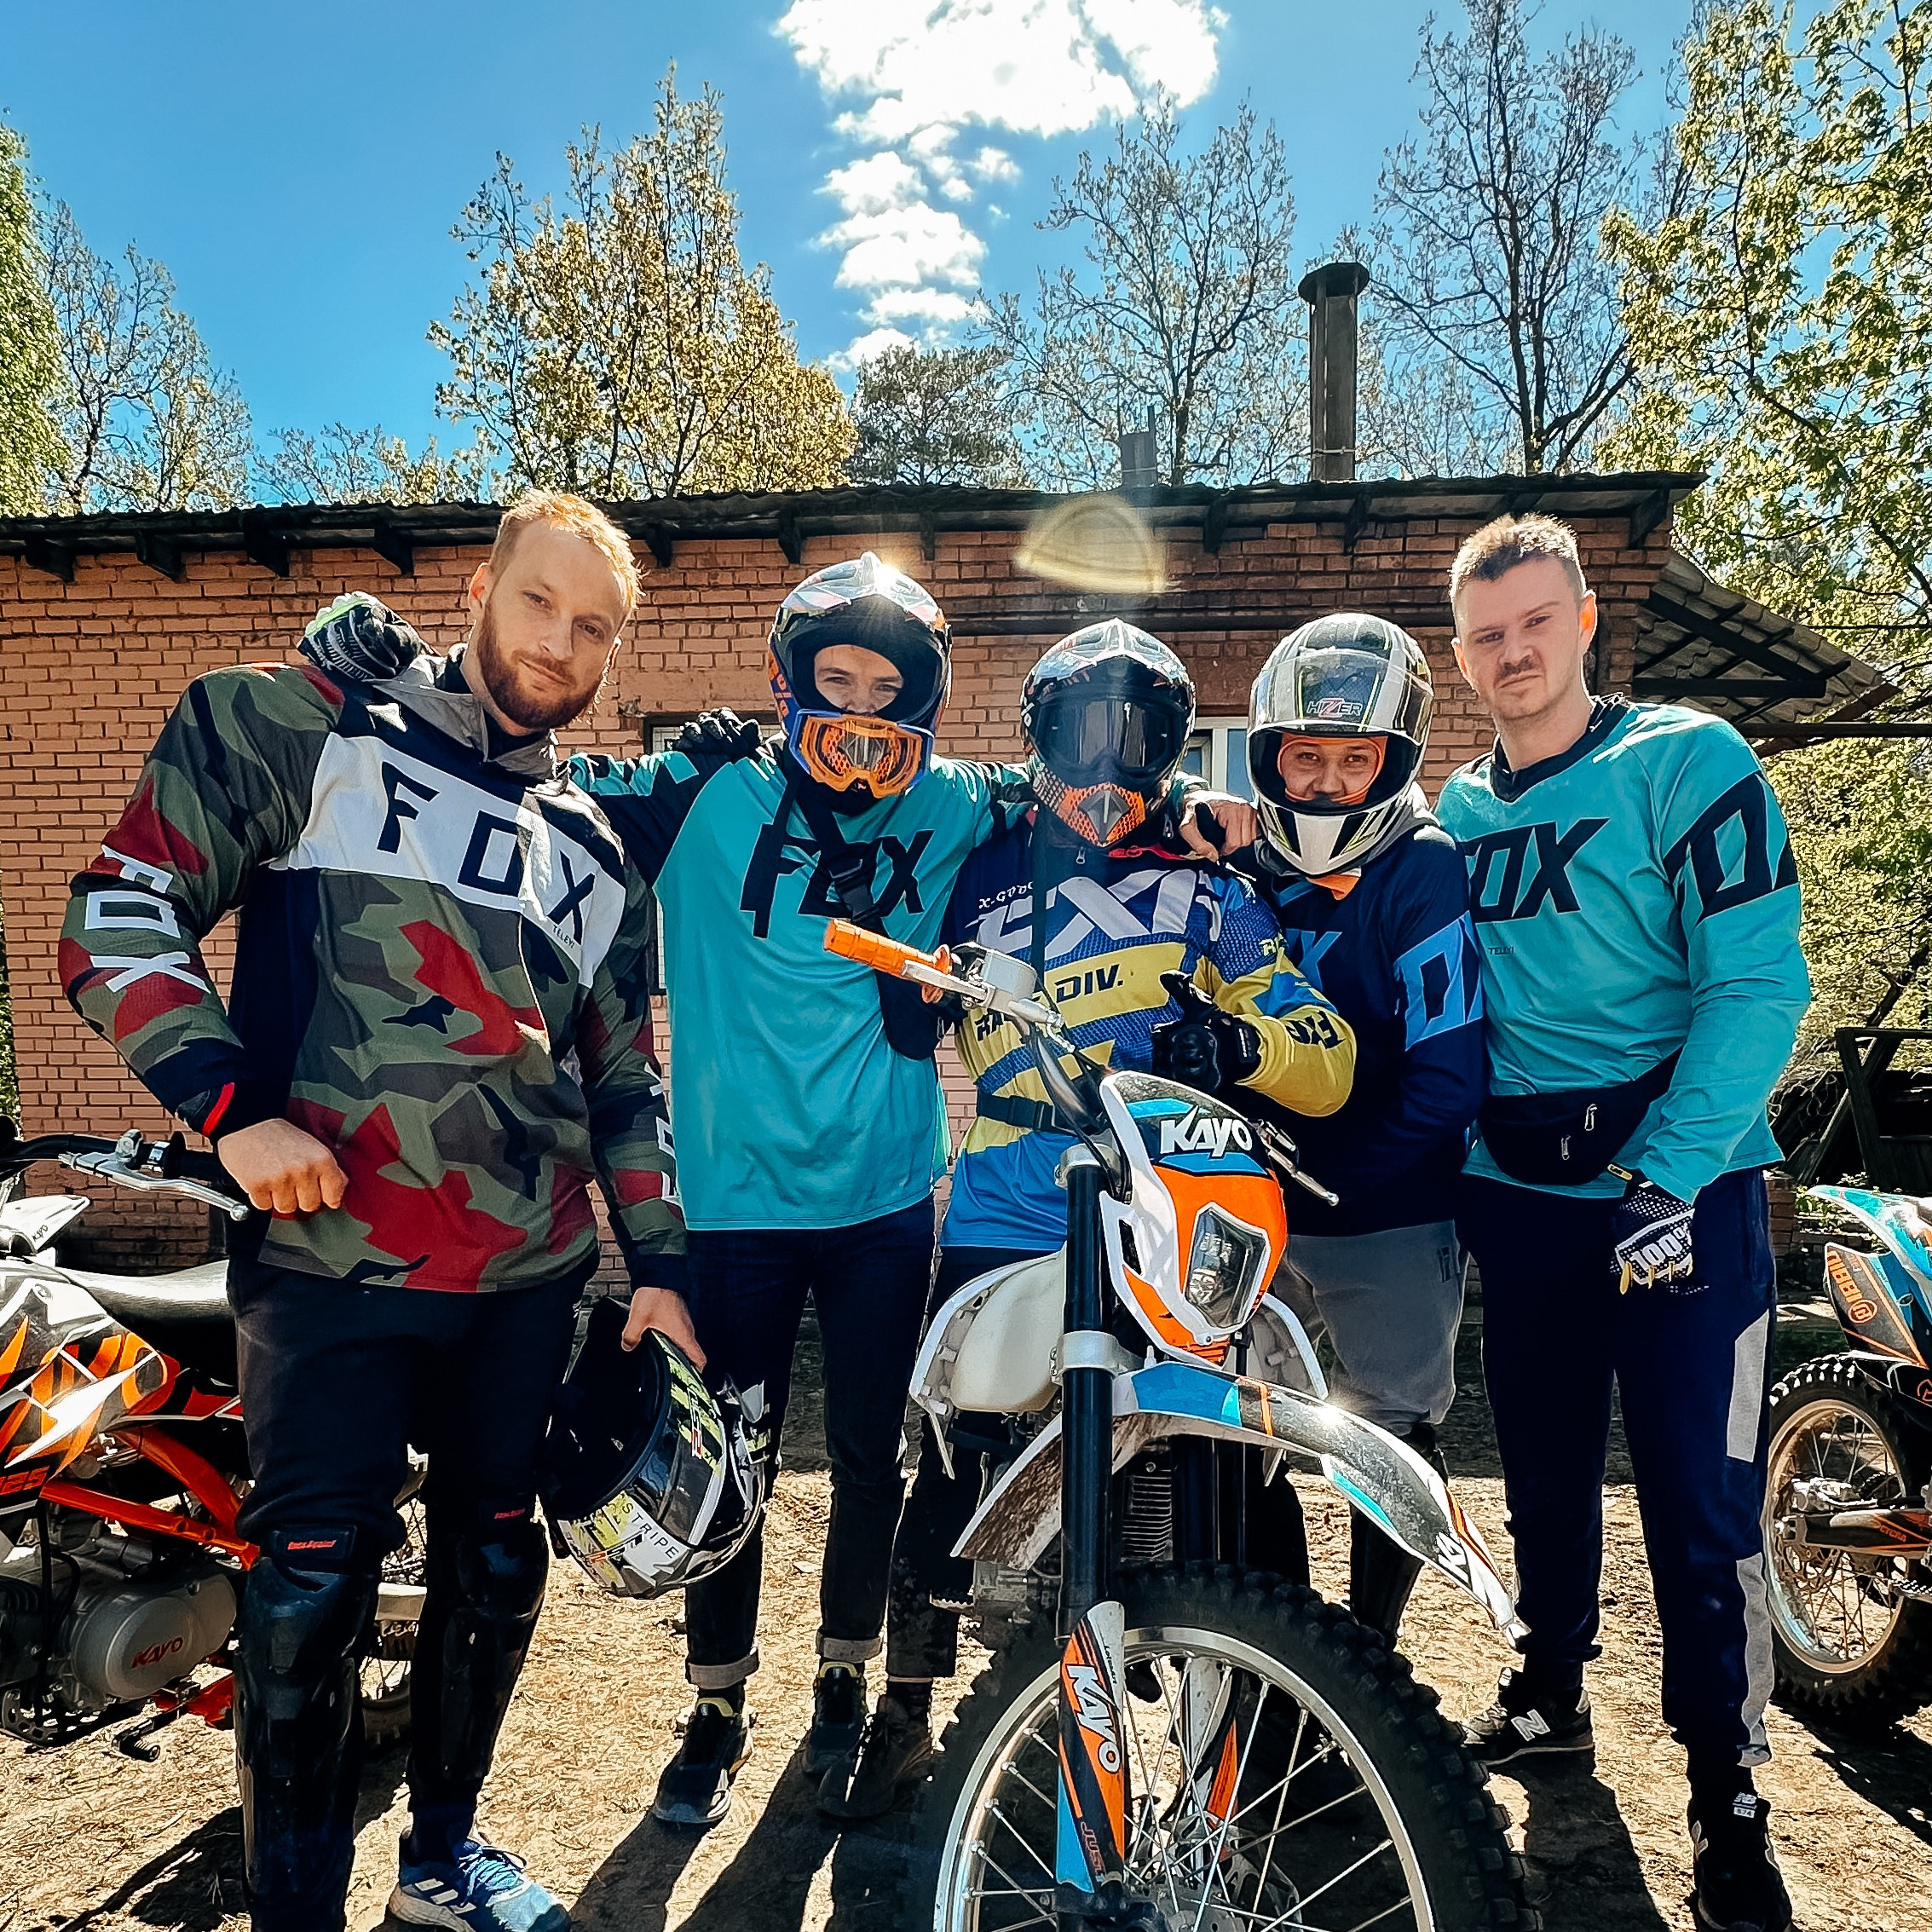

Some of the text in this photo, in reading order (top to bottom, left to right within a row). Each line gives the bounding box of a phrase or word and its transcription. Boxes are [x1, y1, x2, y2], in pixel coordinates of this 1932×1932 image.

[1306, 698, 1363, 718] HIZER
[375, 761, 597, 946] FOX
[85, 844, 211, 994] FOX
[1055, 964, 1123, 1002] DIV.
[1160, 1105, 1253, 1157] KAYO
[621, 1502, 680, 1560] STRIPE
[130, 1637, 183, 1670] KAYO
[1066, 1664, 1121, 1773] KAYO
